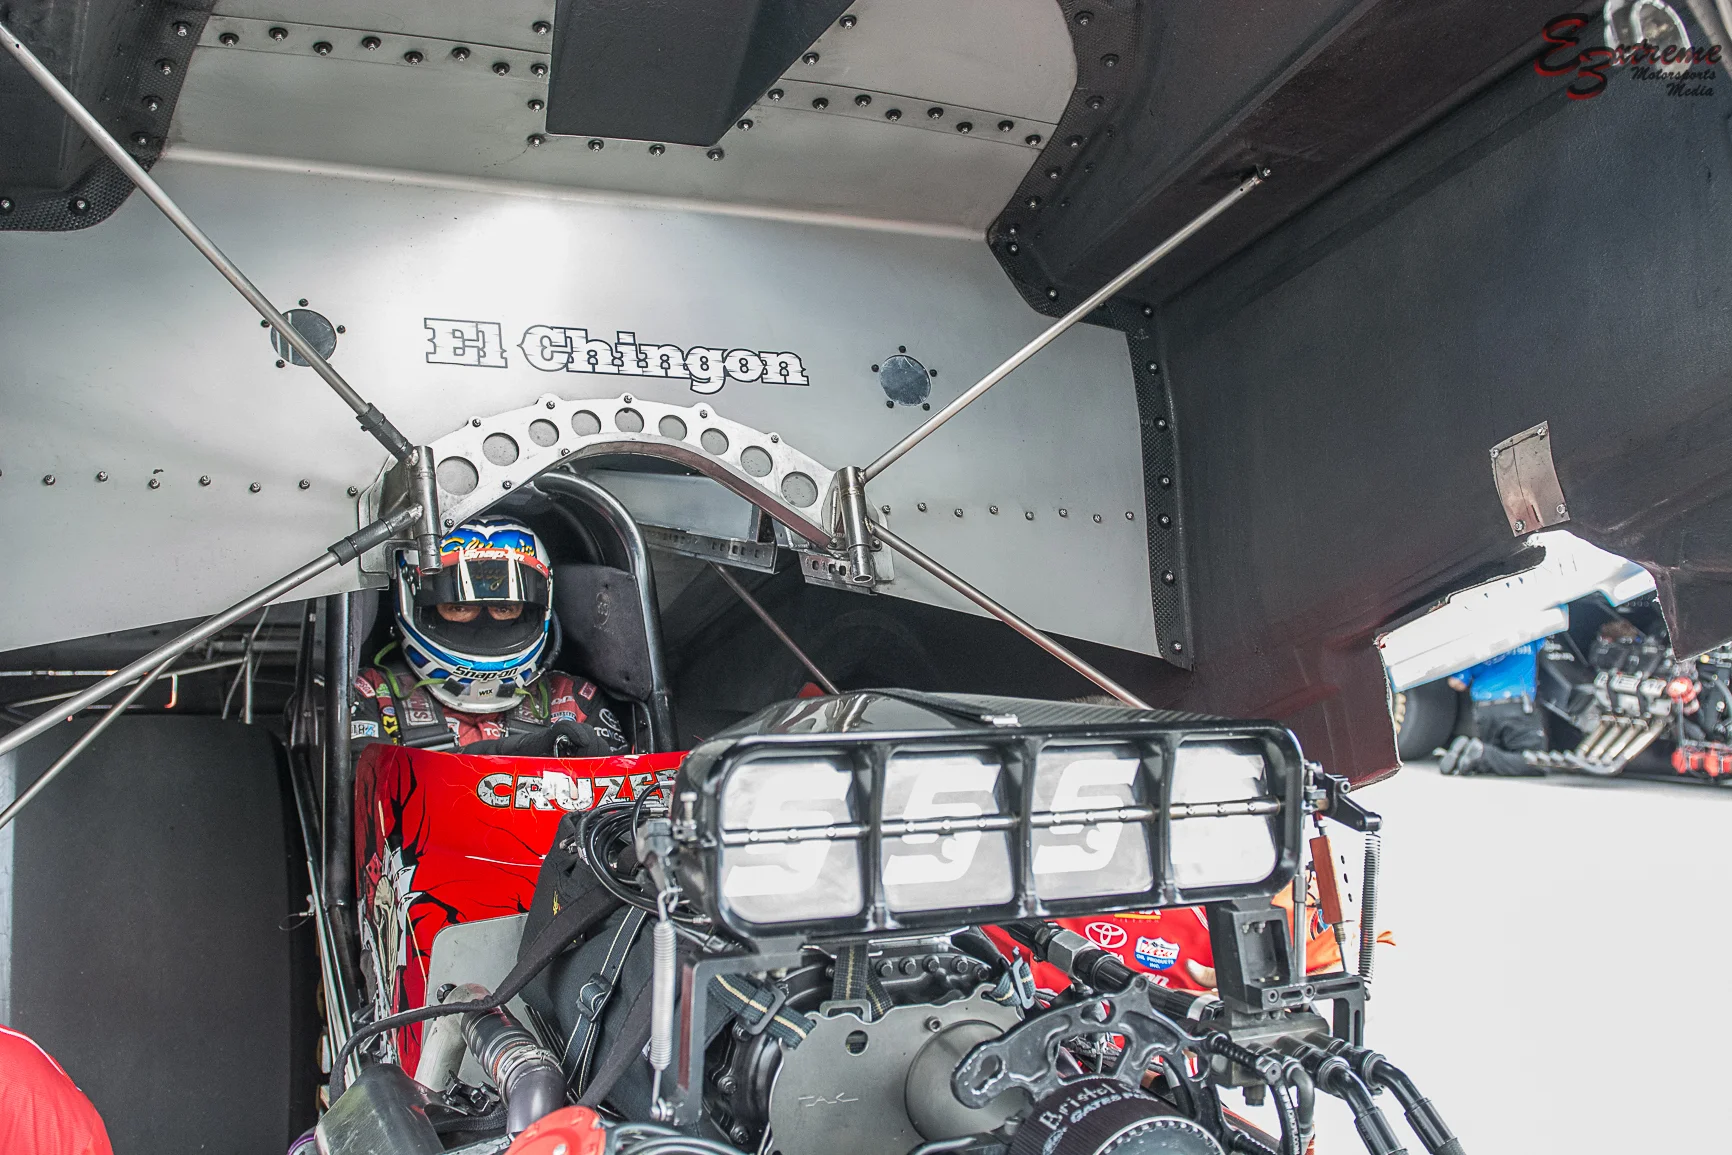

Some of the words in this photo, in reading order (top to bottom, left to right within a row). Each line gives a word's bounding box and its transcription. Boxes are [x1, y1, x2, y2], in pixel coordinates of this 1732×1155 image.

[424, 318, 508, 369] El
[517, 325, 810, 394] Chingon
[453, 666, 519, 680] Snap-on
